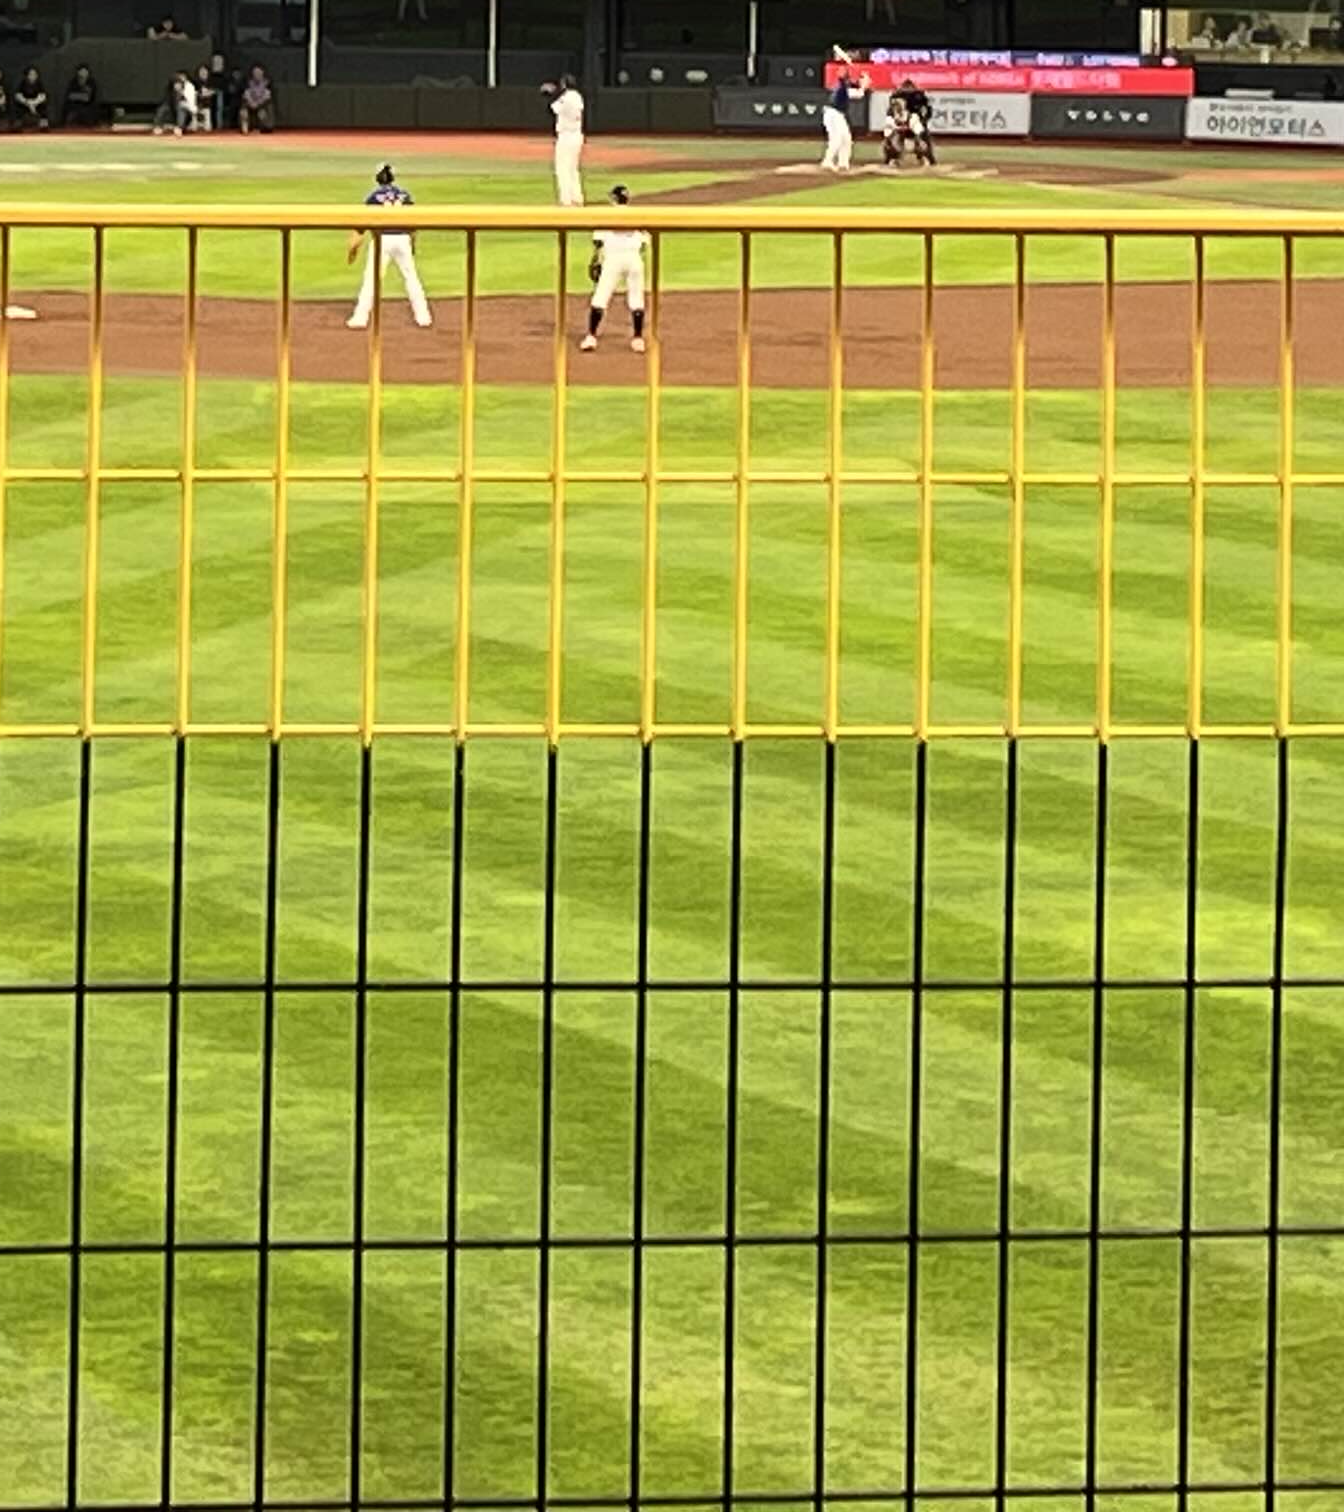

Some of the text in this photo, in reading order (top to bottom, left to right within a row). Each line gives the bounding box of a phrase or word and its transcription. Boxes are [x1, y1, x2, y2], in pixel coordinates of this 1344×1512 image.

[754, 103, 817, 116] VOLV
[1066, 109, 1150, 123] VOLVO
[1207, 115, 1327, 138] 아이언모터스
